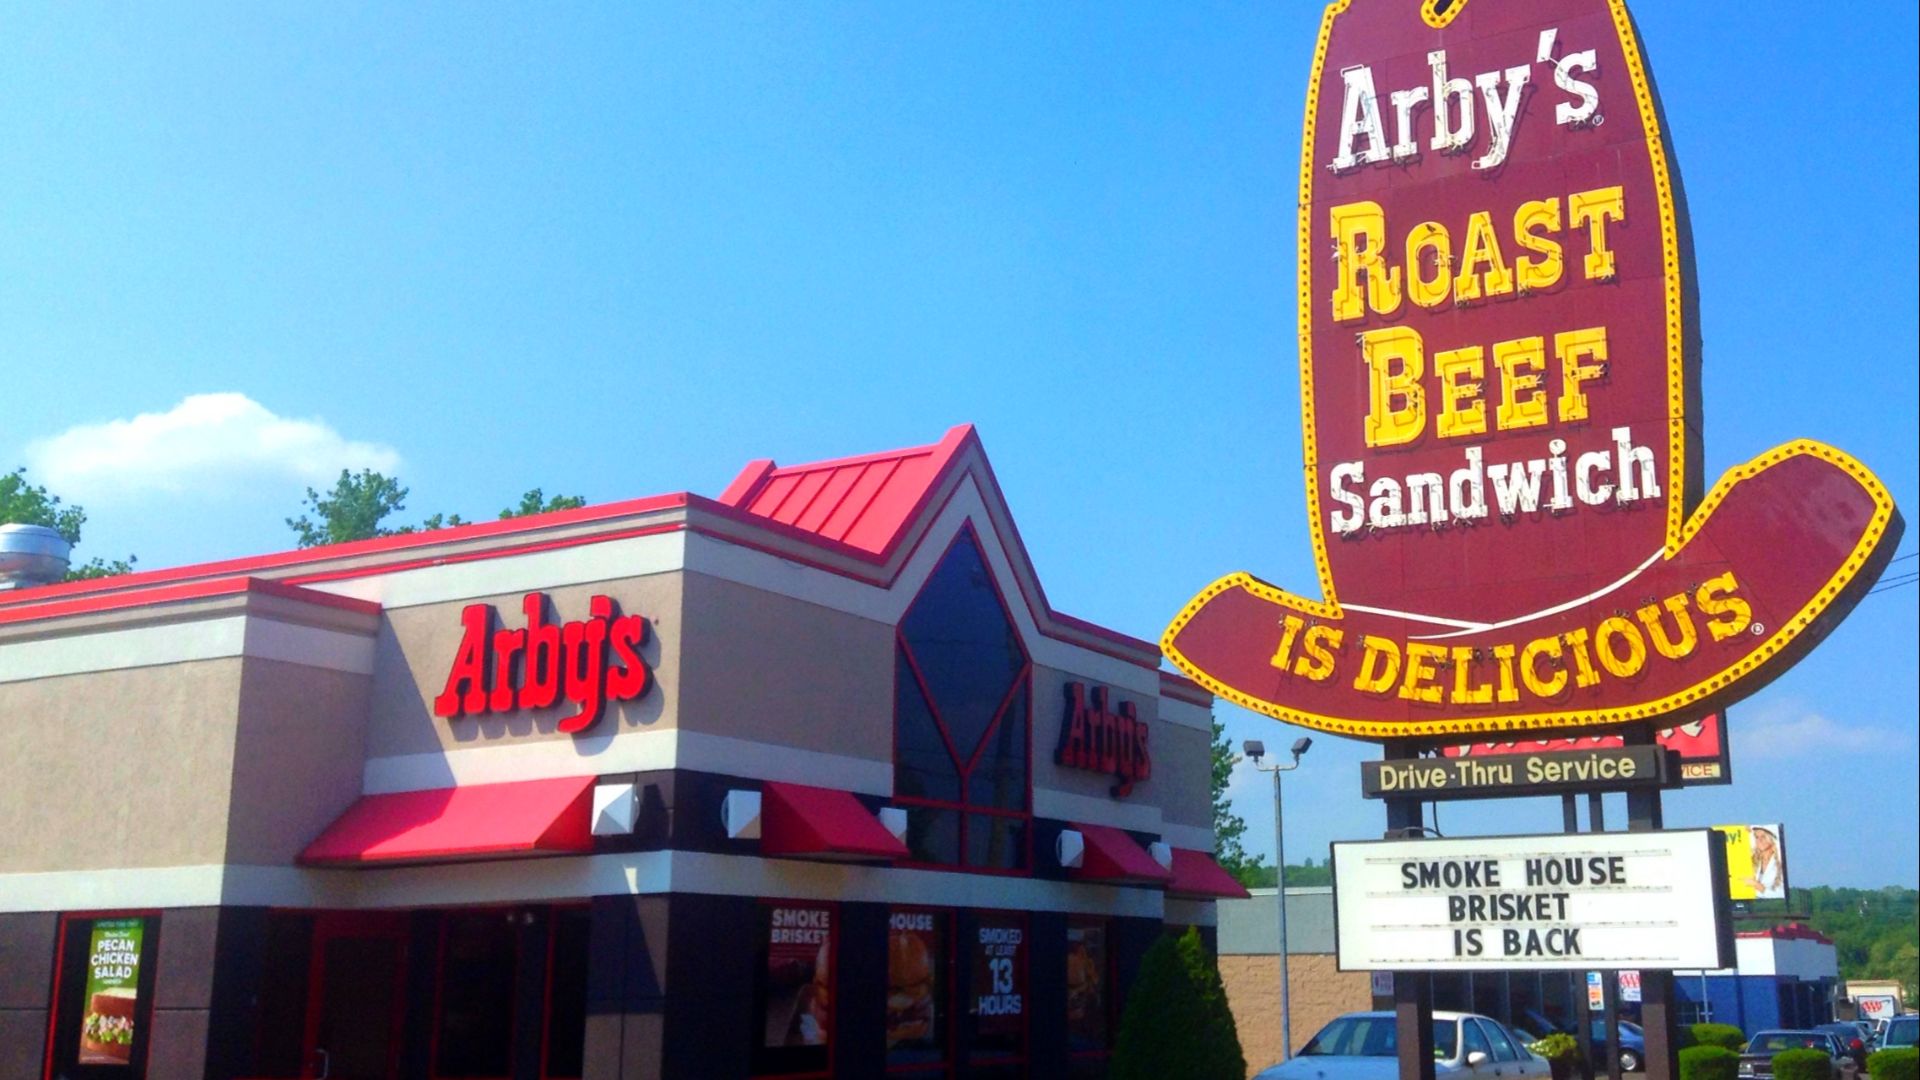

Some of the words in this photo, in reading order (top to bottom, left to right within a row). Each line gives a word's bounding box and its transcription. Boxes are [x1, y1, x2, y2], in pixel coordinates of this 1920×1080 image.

[1327, 28, 1599, 170] Arby's
[1330, 186, 1625, 322] ROAST
[1360, 326, 1609, 450] BEEF
[1330, 427, 1662, 534] Sandwich
[1271, 615, 1344, 682] IS
[1353, 571, 1752, 705] DELICIOUS
[434, 592, 652, 735] Arby's
[1054, 682, 1152, 798] Arby's
[1526, 753, 1636, 784] Service
[1401, 859, 1500, 890] SMOKE
[1525, 856, 1627, 886] HOUSE
[771, 908, 831, 928] SMOKE
[1449, 893, 1571, 923] BRISKET
[97, 939, 135, 952] PECAN
[770, 928, 830, 944] BRISKET
[979, 927, 1023, 945] SMOKED
[1453, 930, 1484, 958] IS
[1503, 927, 1582, 957] BACK
[91, 952, 139, 966] CHICKEN
[94, 966, 132, 979] SALAD
[989, 957, 1014, 994] 13
[978, 993, 1023, 1016] HOURS
